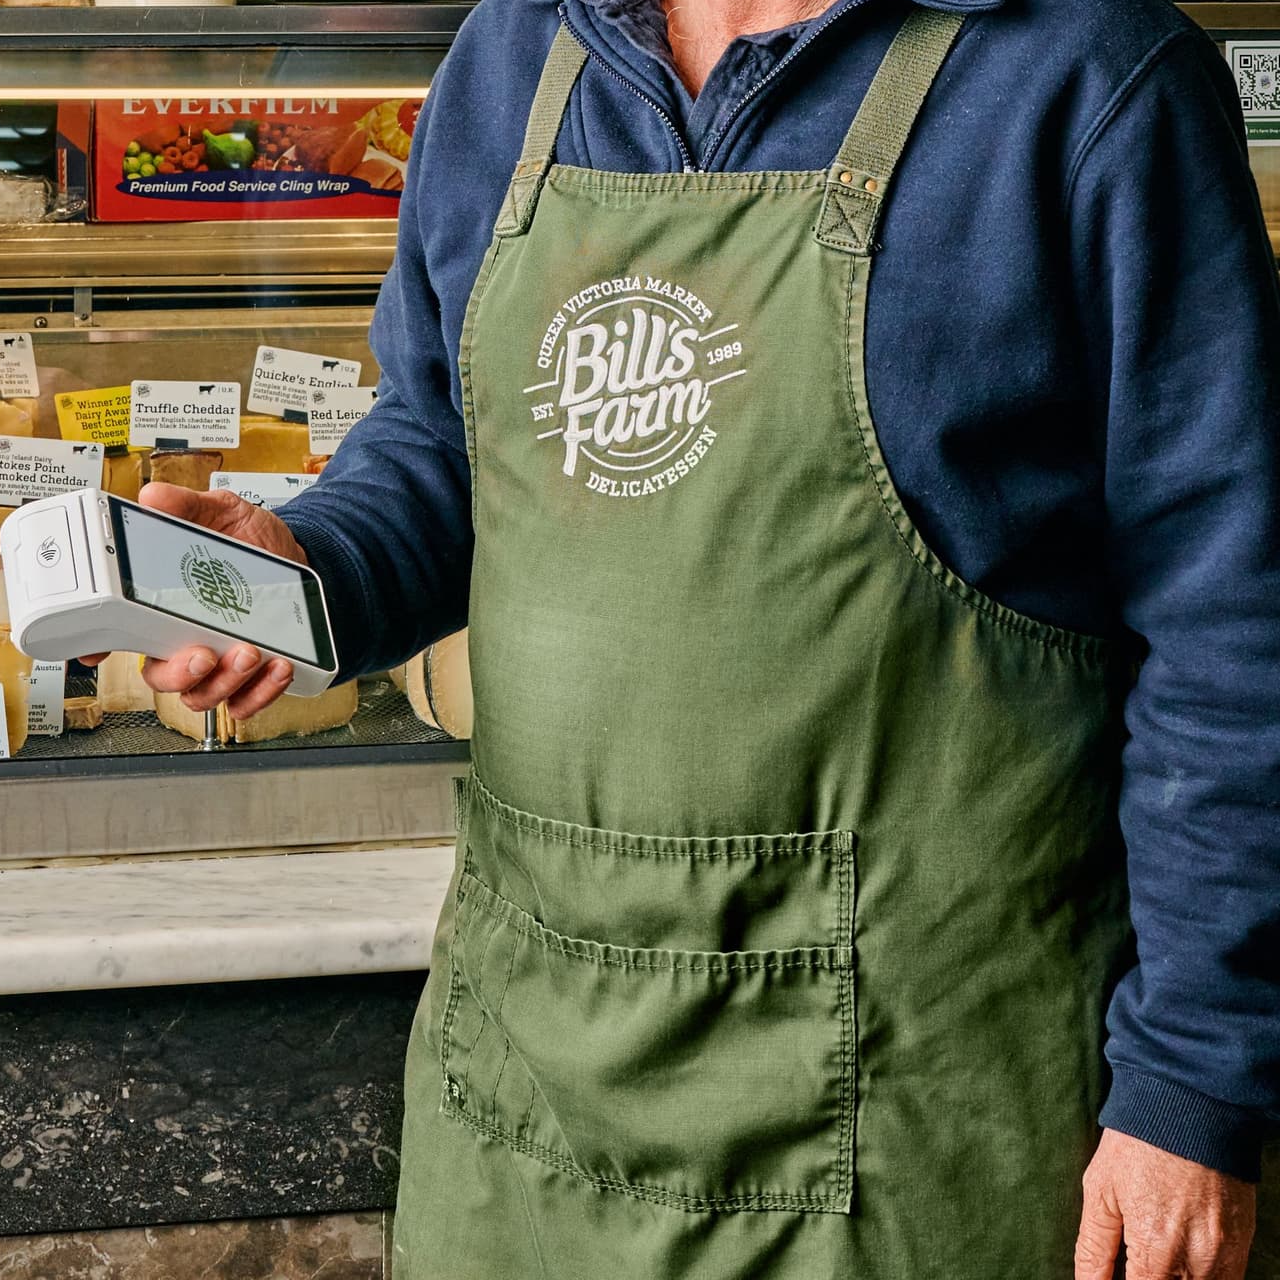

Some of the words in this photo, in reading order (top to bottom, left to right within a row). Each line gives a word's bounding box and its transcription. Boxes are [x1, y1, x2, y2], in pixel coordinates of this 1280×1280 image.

[122, 98, 339, 115] EVERFILM
[130, 181, 188, 192] Premium
[191, 181, 224, 192] Food
[228, 181, 276, 192] Service
[279, 180, 312, 193] Cling
[317, 180, 350, 193] Wrap
[537, 311, 567, 368] QUEEN
[563, 277, 641, 313] VICTORIA
[645, 277, 713, 323] MARKET
[559, 308, 699, 407] Bill's
[707, 341, 742, 365] 1989
[255, 368, 306, 385] Quicke's
[77, 399, 113, 409] Winner
[136, 403, 179, 414] Truffle
[183, 404, 236, 415] Cheddar
[531, 403, 554, 421] EST
[76, 412, 101, 420] Dairy
[311, 410, 332, 420] Red
[82, 421, 102, 430] Best
[563, 379, 712, 476] Farm
[91, 430, 125, 439] Cheese
[35, 463, 65, 474] Point
[585, 425, 718, 496] DELICATESSEN
[40, 474, 88, 486] Cheddar
[191, 559, 228, 609] Bill's
[209, 558, 250, 615] Farm
